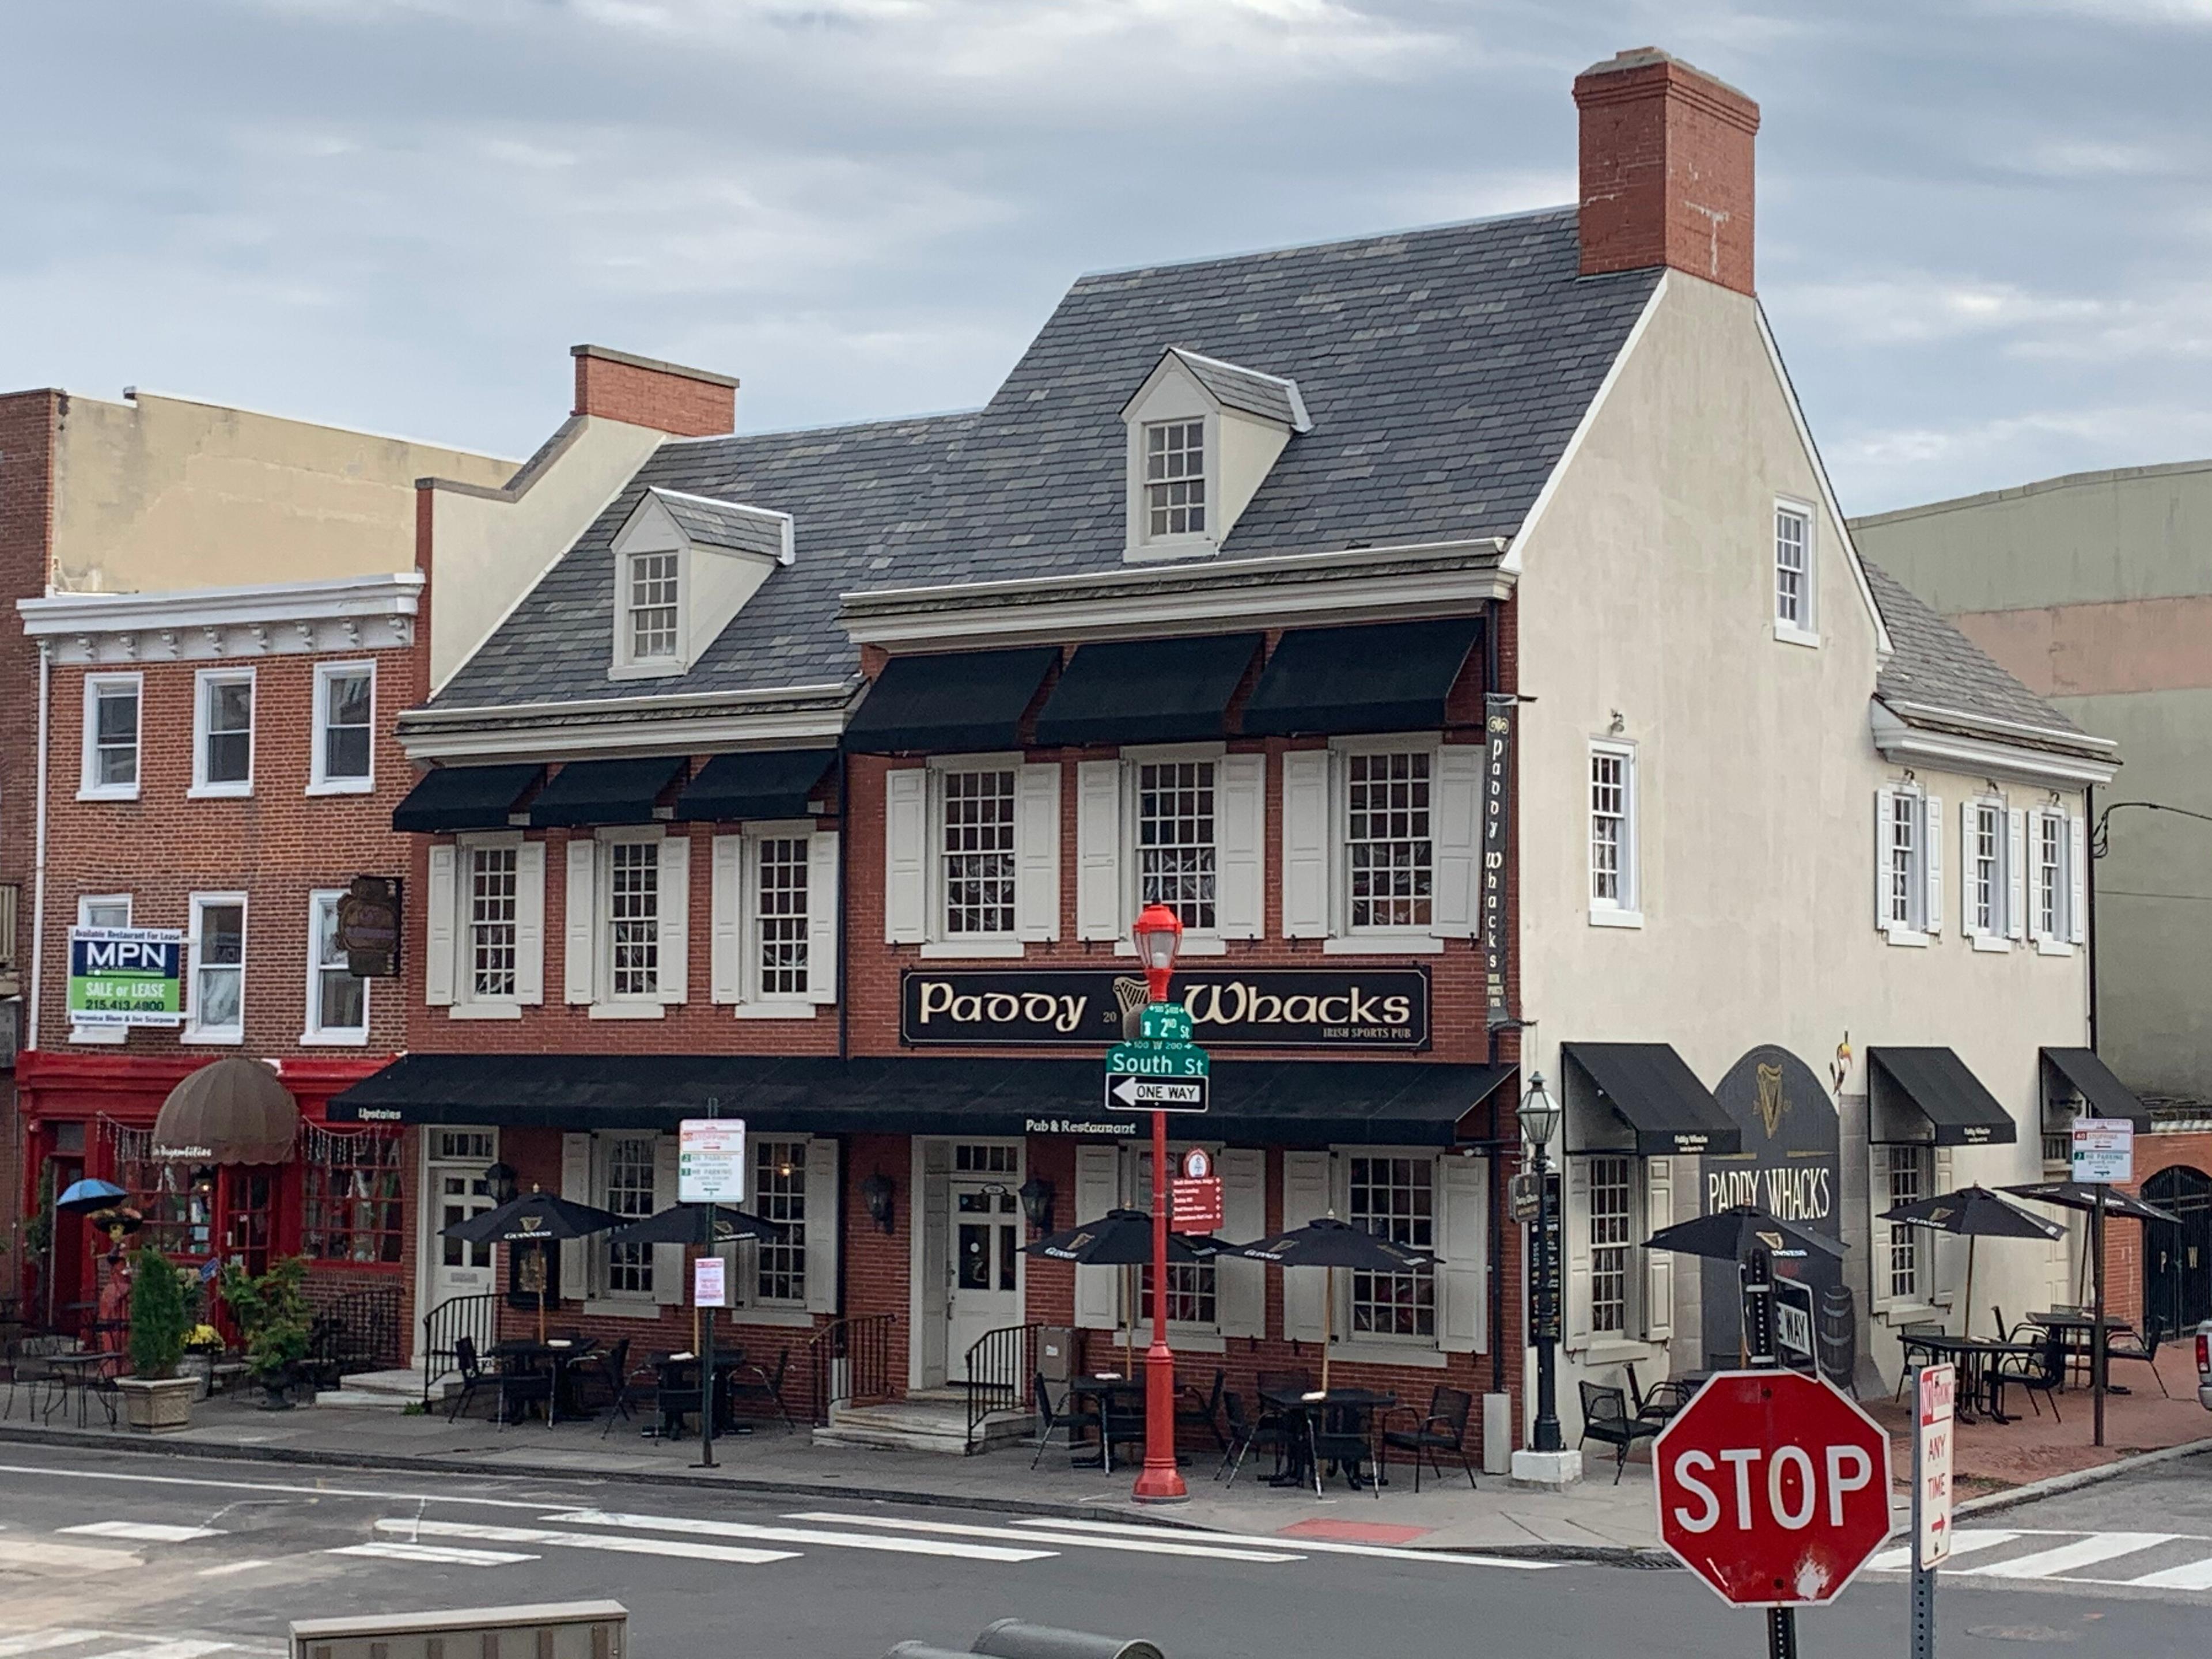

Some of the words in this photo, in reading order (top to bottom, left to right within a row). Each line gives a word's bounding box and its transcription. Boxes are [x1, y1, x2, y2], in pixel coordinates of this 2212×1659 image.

[88, 942, 166, 967] MPN
[86, 982, 113, 997] SALE
[116, 986, 128, 997] or
[132, 983, 165, 998] LEASE
[919, 981, 1087, 1033] Paddy
[1184, 982, 1410, 1025] Whacks
[1103, 1012, 1117, 1023] 20
[1323, 1028, 1349, 1037] IRISH
[1351, 1028, 1389, 1038] SPORTS
[1391, 1028, 1411, 1039] PUB
[1112, 1052, 1172, 1074] South
[1185, 1058, 1203, 1075] St
[1137, 1085, 1163, 1099] ONE
[1168, 1086, 1195, 1099] WAY
[1026, 1119, 1048, 1132] Pub
[1050, 1120, 1059, 1132] &
[1061, 1120, 1136, 1134] Restaurant
[1709, 1170, 1759, 1215] PADDY
[1765, 1168, 1830, 1221] WHACKS
[1785, 1309, 1806, 1349] WAY
[1928, 1433, 1946, 1462] ANY
[1674, 1445, 1873, 1533] STOP
[1927, 1472, 1946, 1501] TIME
